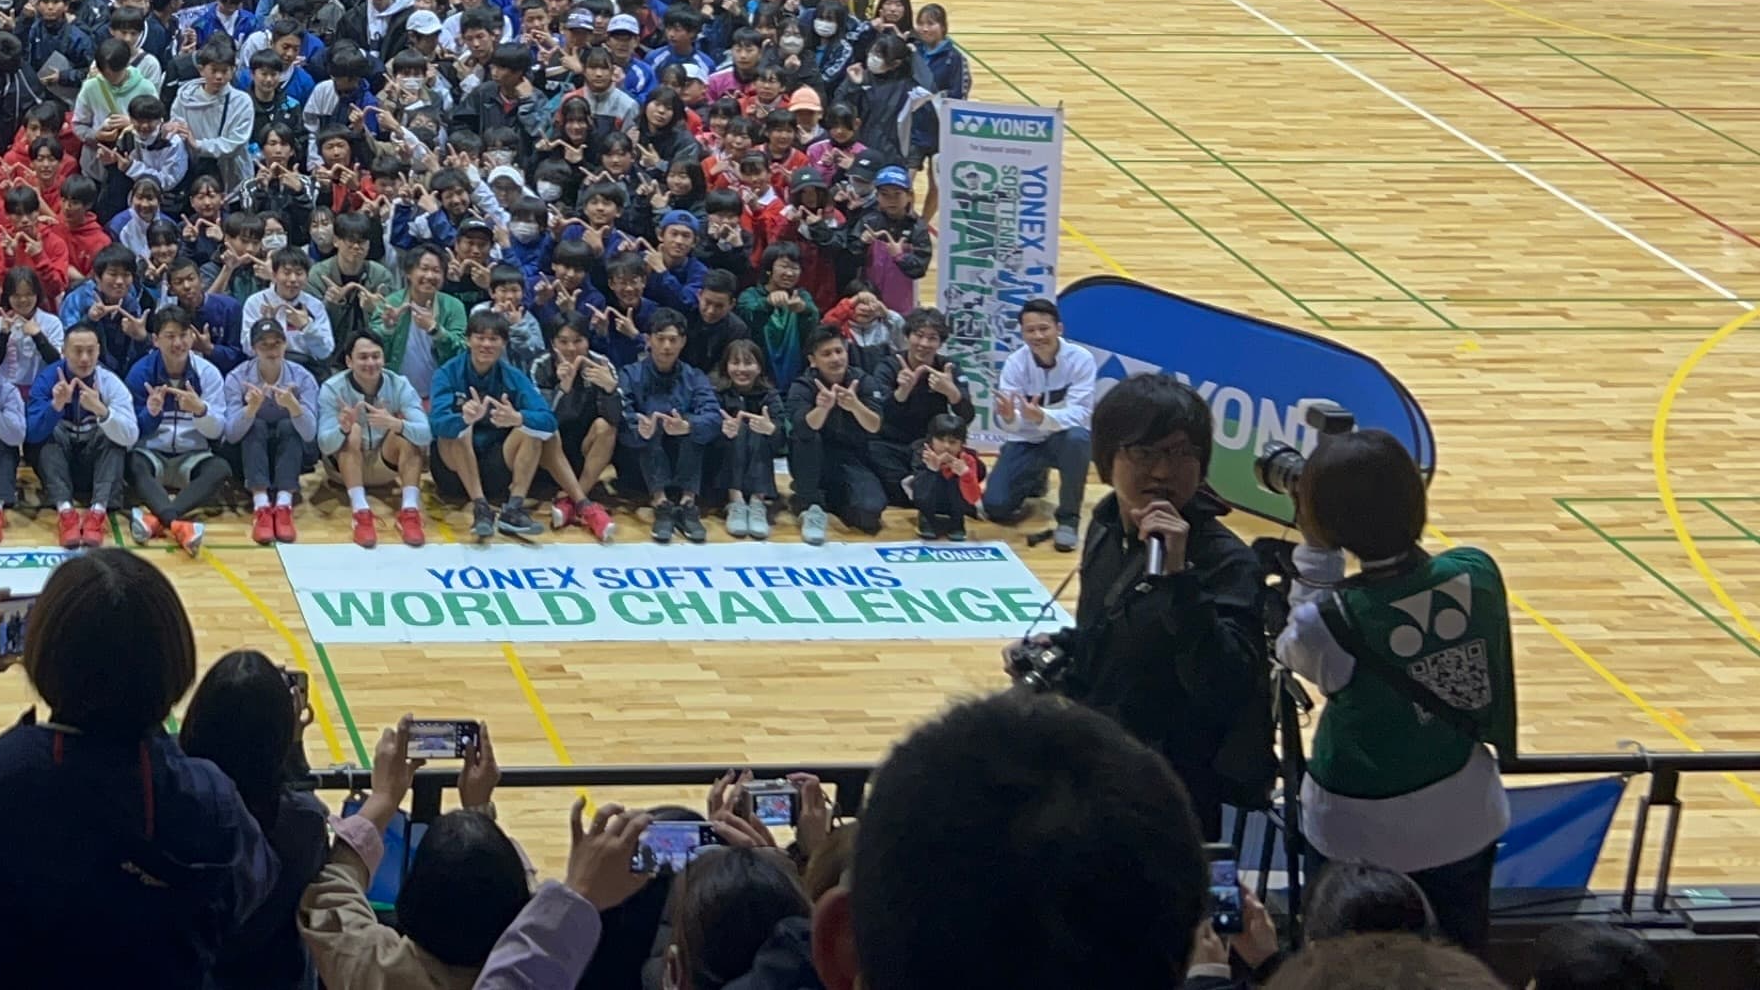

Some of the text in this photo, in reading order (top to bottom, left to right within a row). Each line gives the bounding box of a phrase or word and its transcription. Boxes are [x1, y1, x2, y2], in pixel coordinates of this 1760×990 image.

[990, 117, 1048, 138] YONEX
[1018, 164, 1049, 252] YONEX
[927, 549, 997, 561] YONEX
[427, 565, 903, 590] YONEX SOFT TENNIS
[311, 587, 1058, 627] WORLD CHALLENGE
